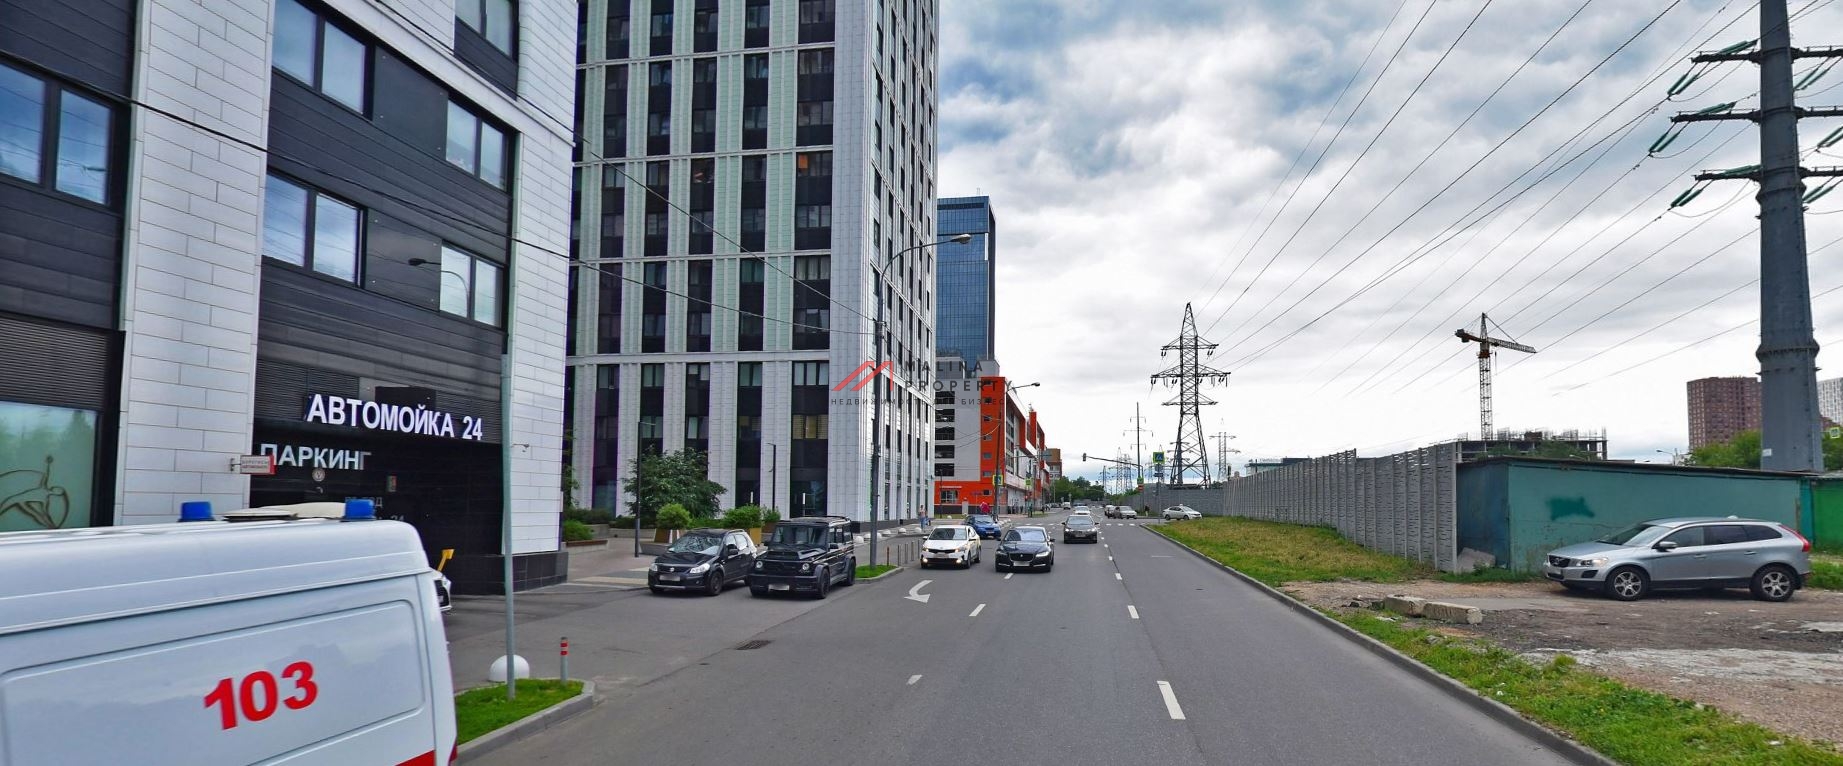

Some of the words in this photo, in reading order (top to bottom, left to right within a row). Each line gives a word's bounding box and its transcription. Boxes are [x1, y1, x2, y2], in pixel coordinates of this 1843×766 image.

[307, 393, 455, 438] АВТОМОЙКА
[462, 415, 483, 441] 24
[260, 443, 372, 470] ПАРКИНГ
[203, 661, 318, 731] 103
